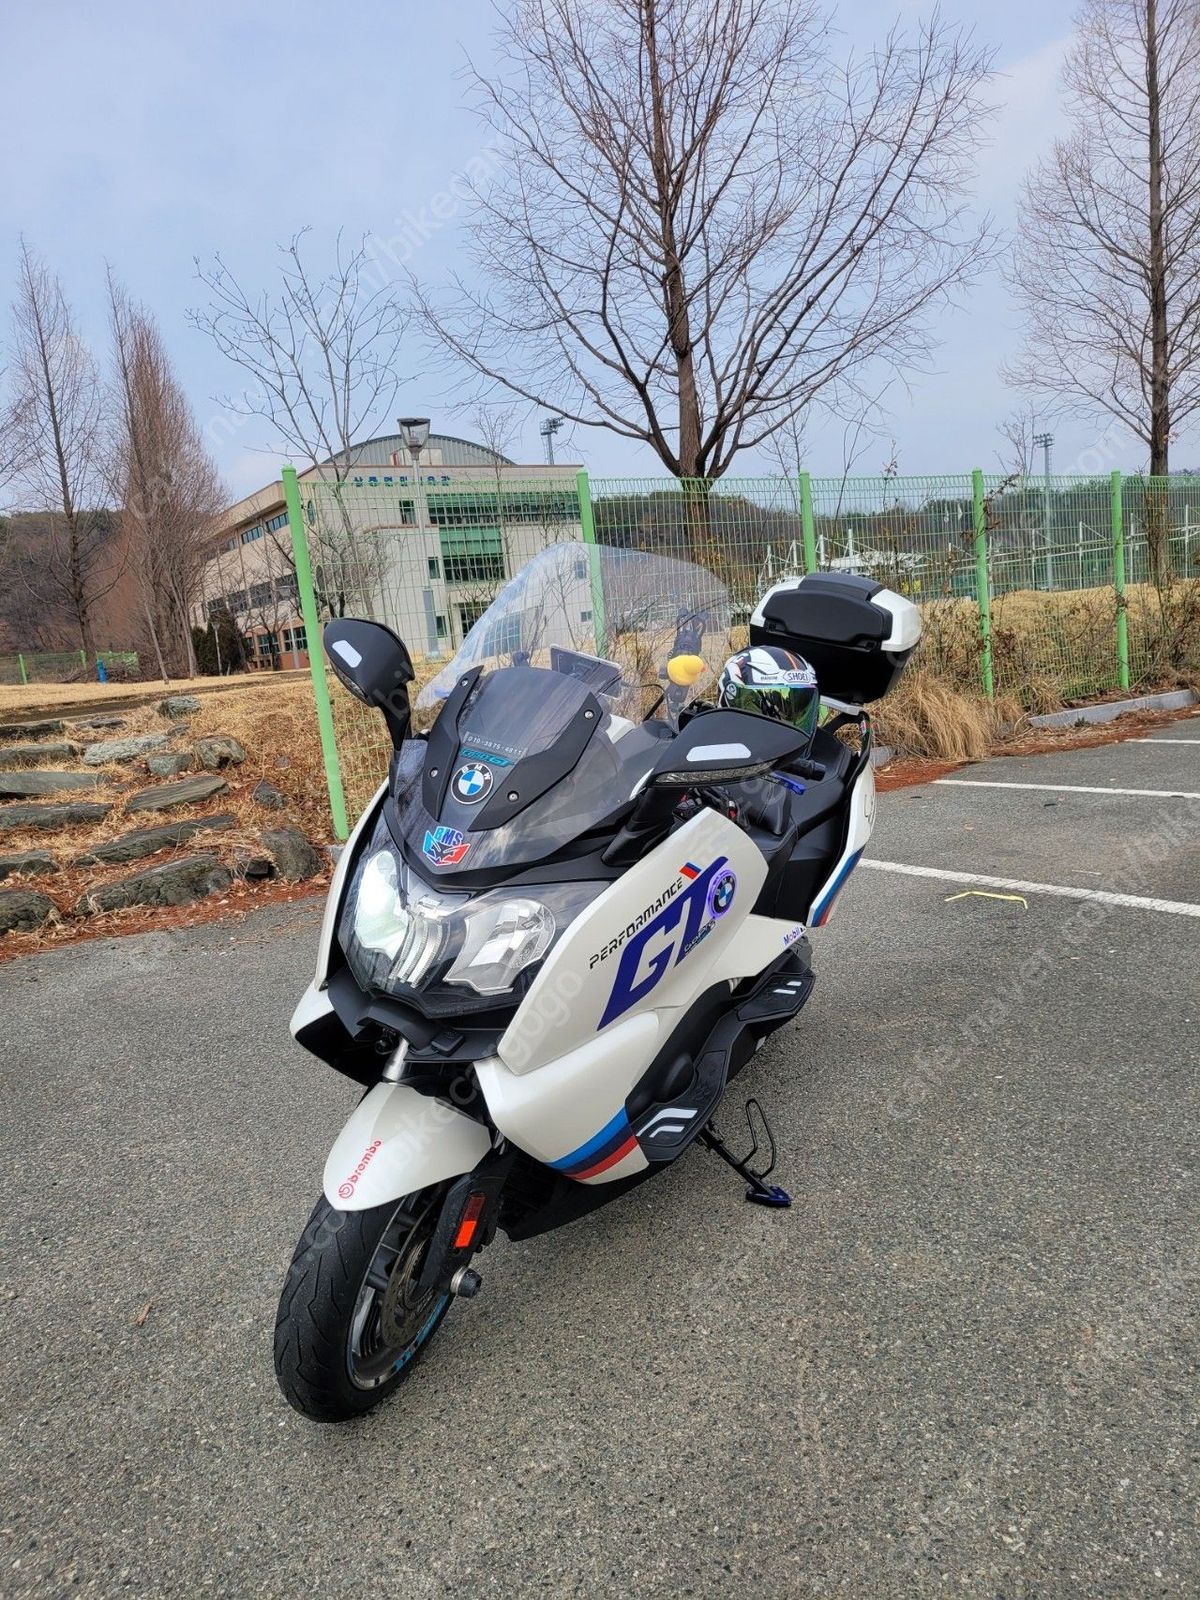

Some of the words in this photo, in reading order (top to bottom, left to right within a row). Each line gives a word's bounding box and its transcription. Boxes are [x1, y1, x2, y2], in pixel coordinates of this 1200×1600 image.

[787, 671, 808, 681] SHOEI
[433, 826, 463, 846] BMS
[589, 876, 684, 970] PERFORMANCE
[348, 1140, 382, 1184] brembo
